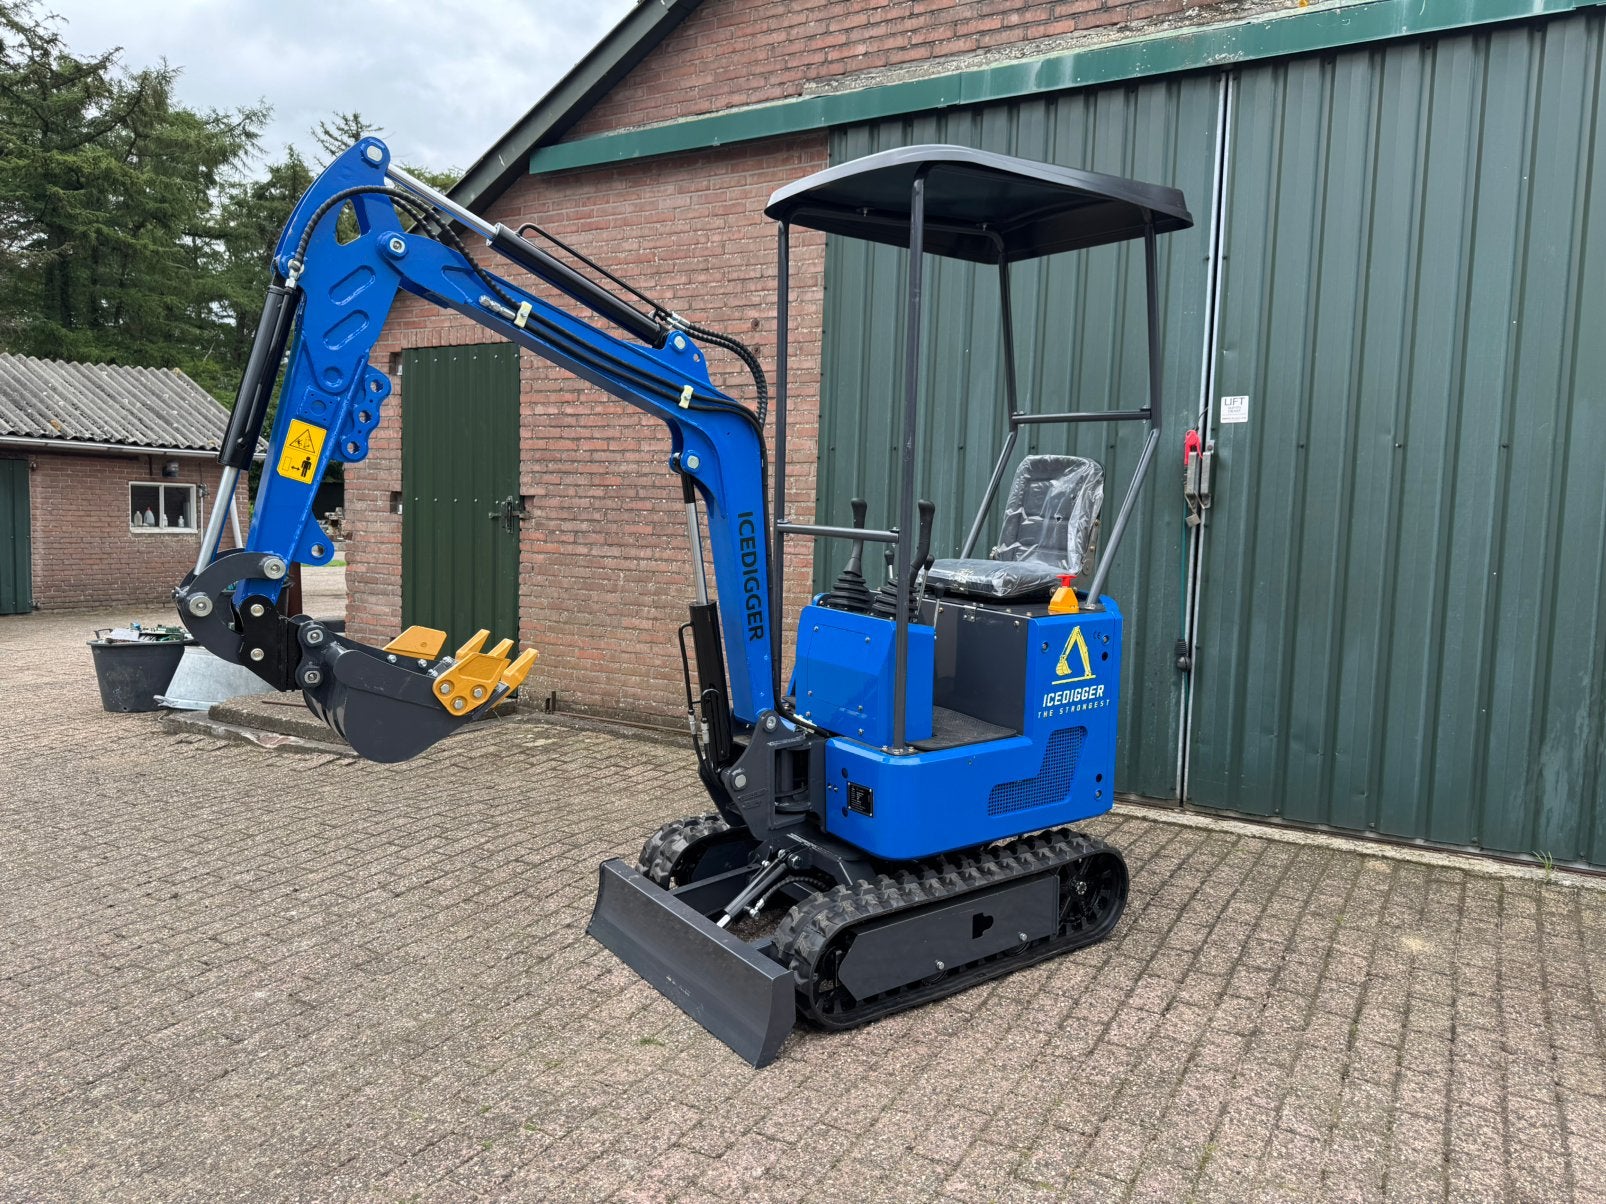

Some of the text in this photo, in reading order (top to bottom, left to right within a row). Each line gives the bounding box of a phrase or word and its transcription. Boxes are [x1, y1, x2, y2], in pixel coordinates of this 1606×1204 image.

[1224, 397, 1246, 406] LIFT
[737, 511, 765, 642] ICEDIGGER
[1042, 684, 1105, 707] ICEDIGGER
[1037, 699, 1110, 719] THE STRONGEST
